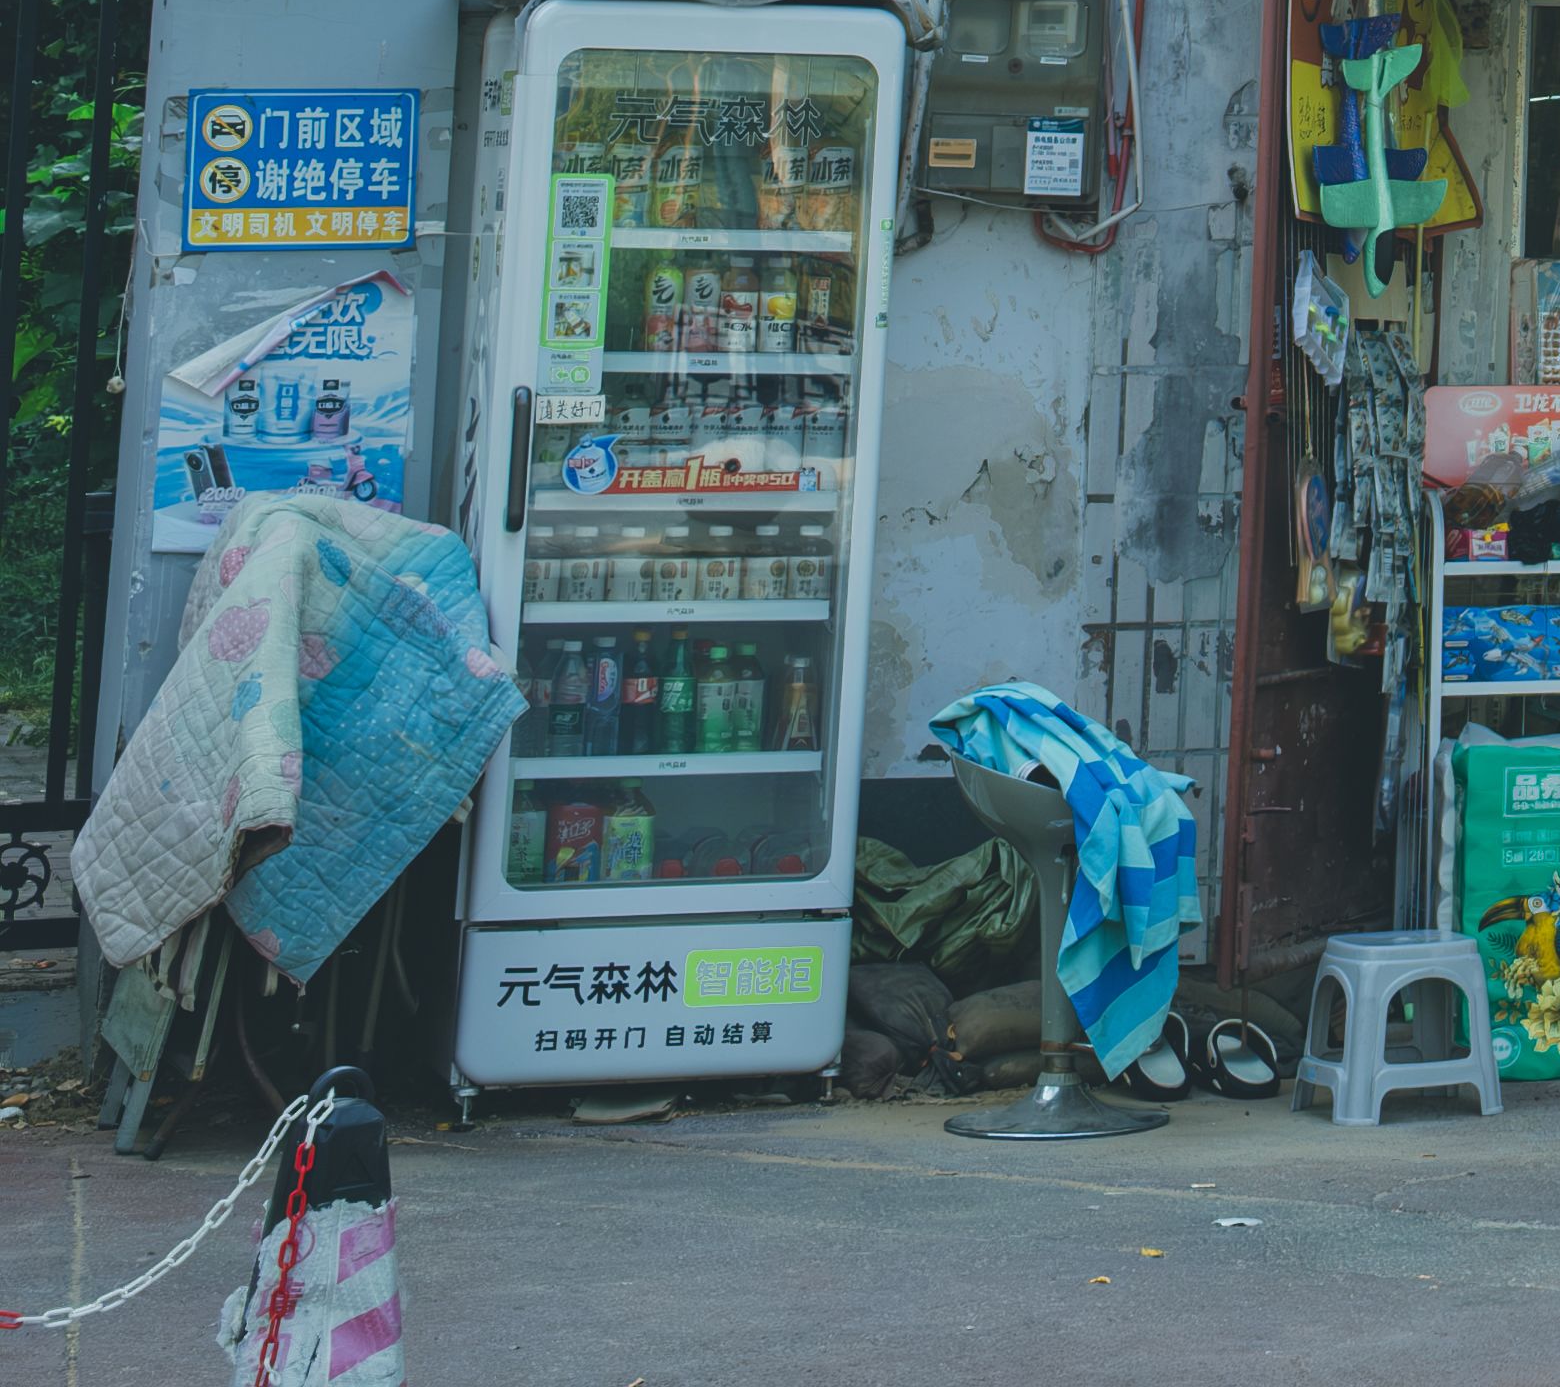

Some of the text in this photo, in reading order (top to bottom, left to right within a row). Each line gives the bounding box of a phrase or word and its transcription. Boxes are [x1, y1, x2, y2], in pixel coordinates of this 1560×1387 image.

[258, 107, 403, 149] 门前区域
[607, 95, 822, 147] 元气森林
[256, 158, 401, 201] 谢绝停车
[194, 211, 404, 238] 文明司机 文明停车
[496, 955, 815, 1008] 元气森林 智能柜
[534, 1020, 774, 1052] 扫码开门 自动结算
